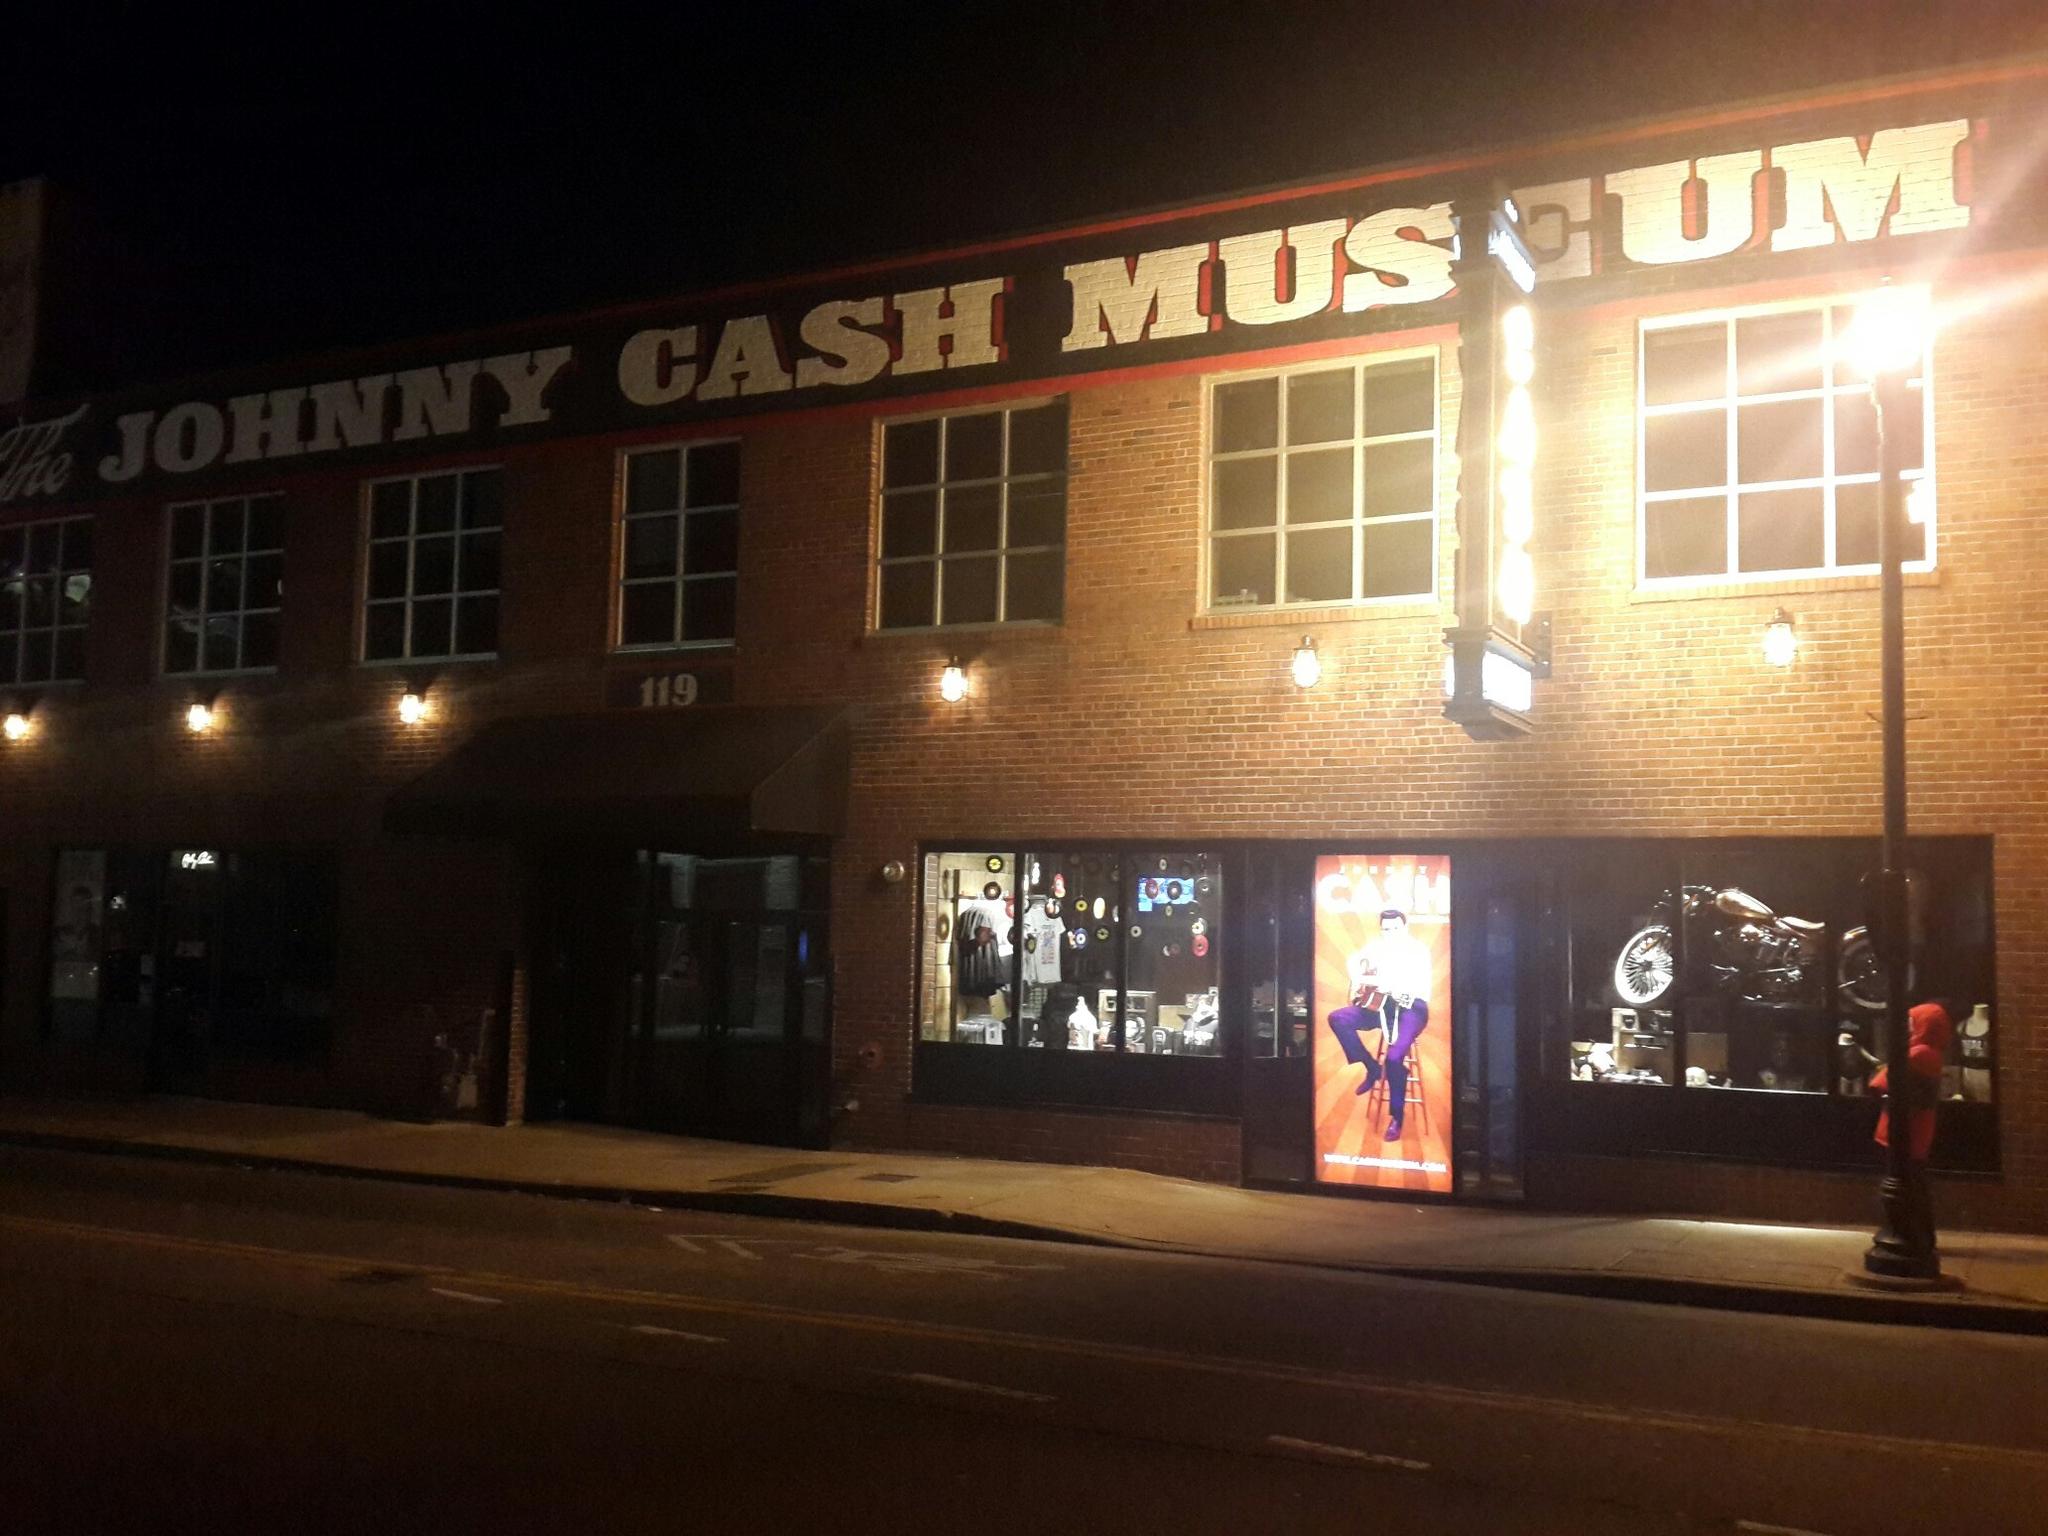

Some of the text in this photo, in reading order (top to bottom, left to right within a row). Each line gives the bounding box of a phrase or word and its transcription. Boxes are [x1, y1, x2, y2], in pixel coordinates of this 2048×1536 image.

[0, 403, 91, 502] The
[98, 346, 572, 483] JOHNNY
[618, 277, 1005, 407] CASH
[1062, 118, 1970, 353] MUSEUM
[640, 672, 698, 707] 119
